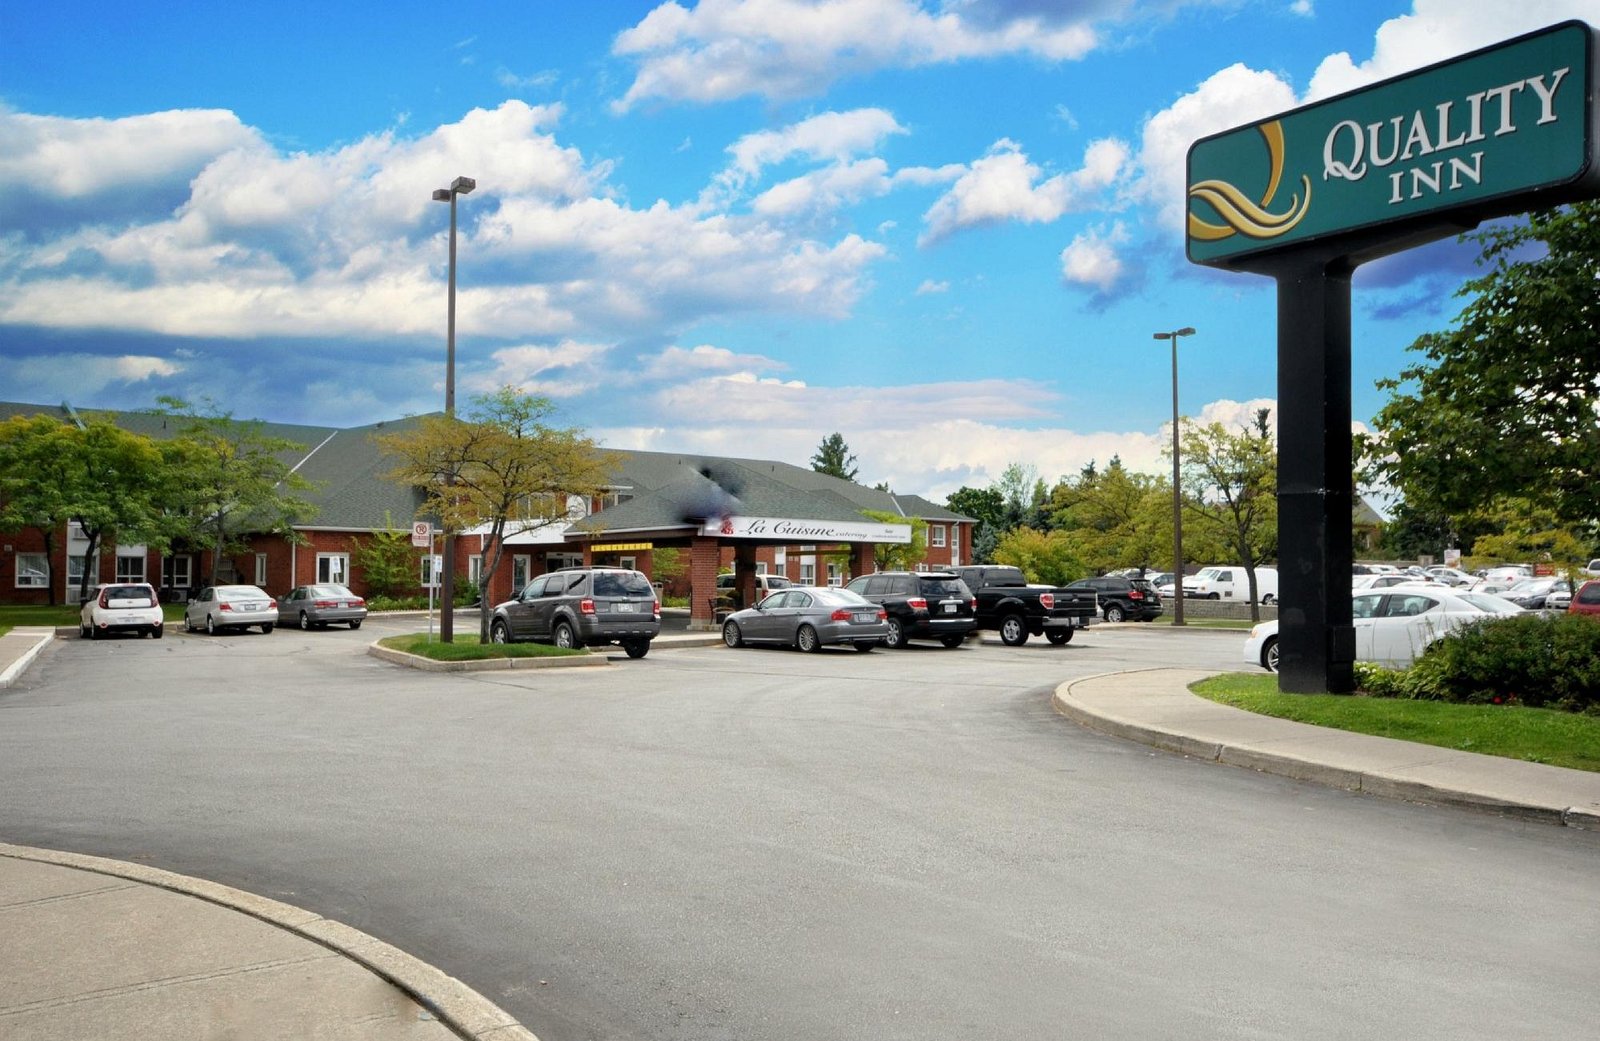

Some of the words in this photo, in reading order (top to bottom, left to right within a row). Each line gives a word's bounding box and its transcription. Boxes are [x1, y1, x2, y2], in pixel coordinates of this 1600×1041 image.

[1323, 67, 1569, 181] QUALITY
[1388, 151, 1485, 205] INN
[740, 519, 766, 535] La
[773, 520, 835, 537] Cuisine
